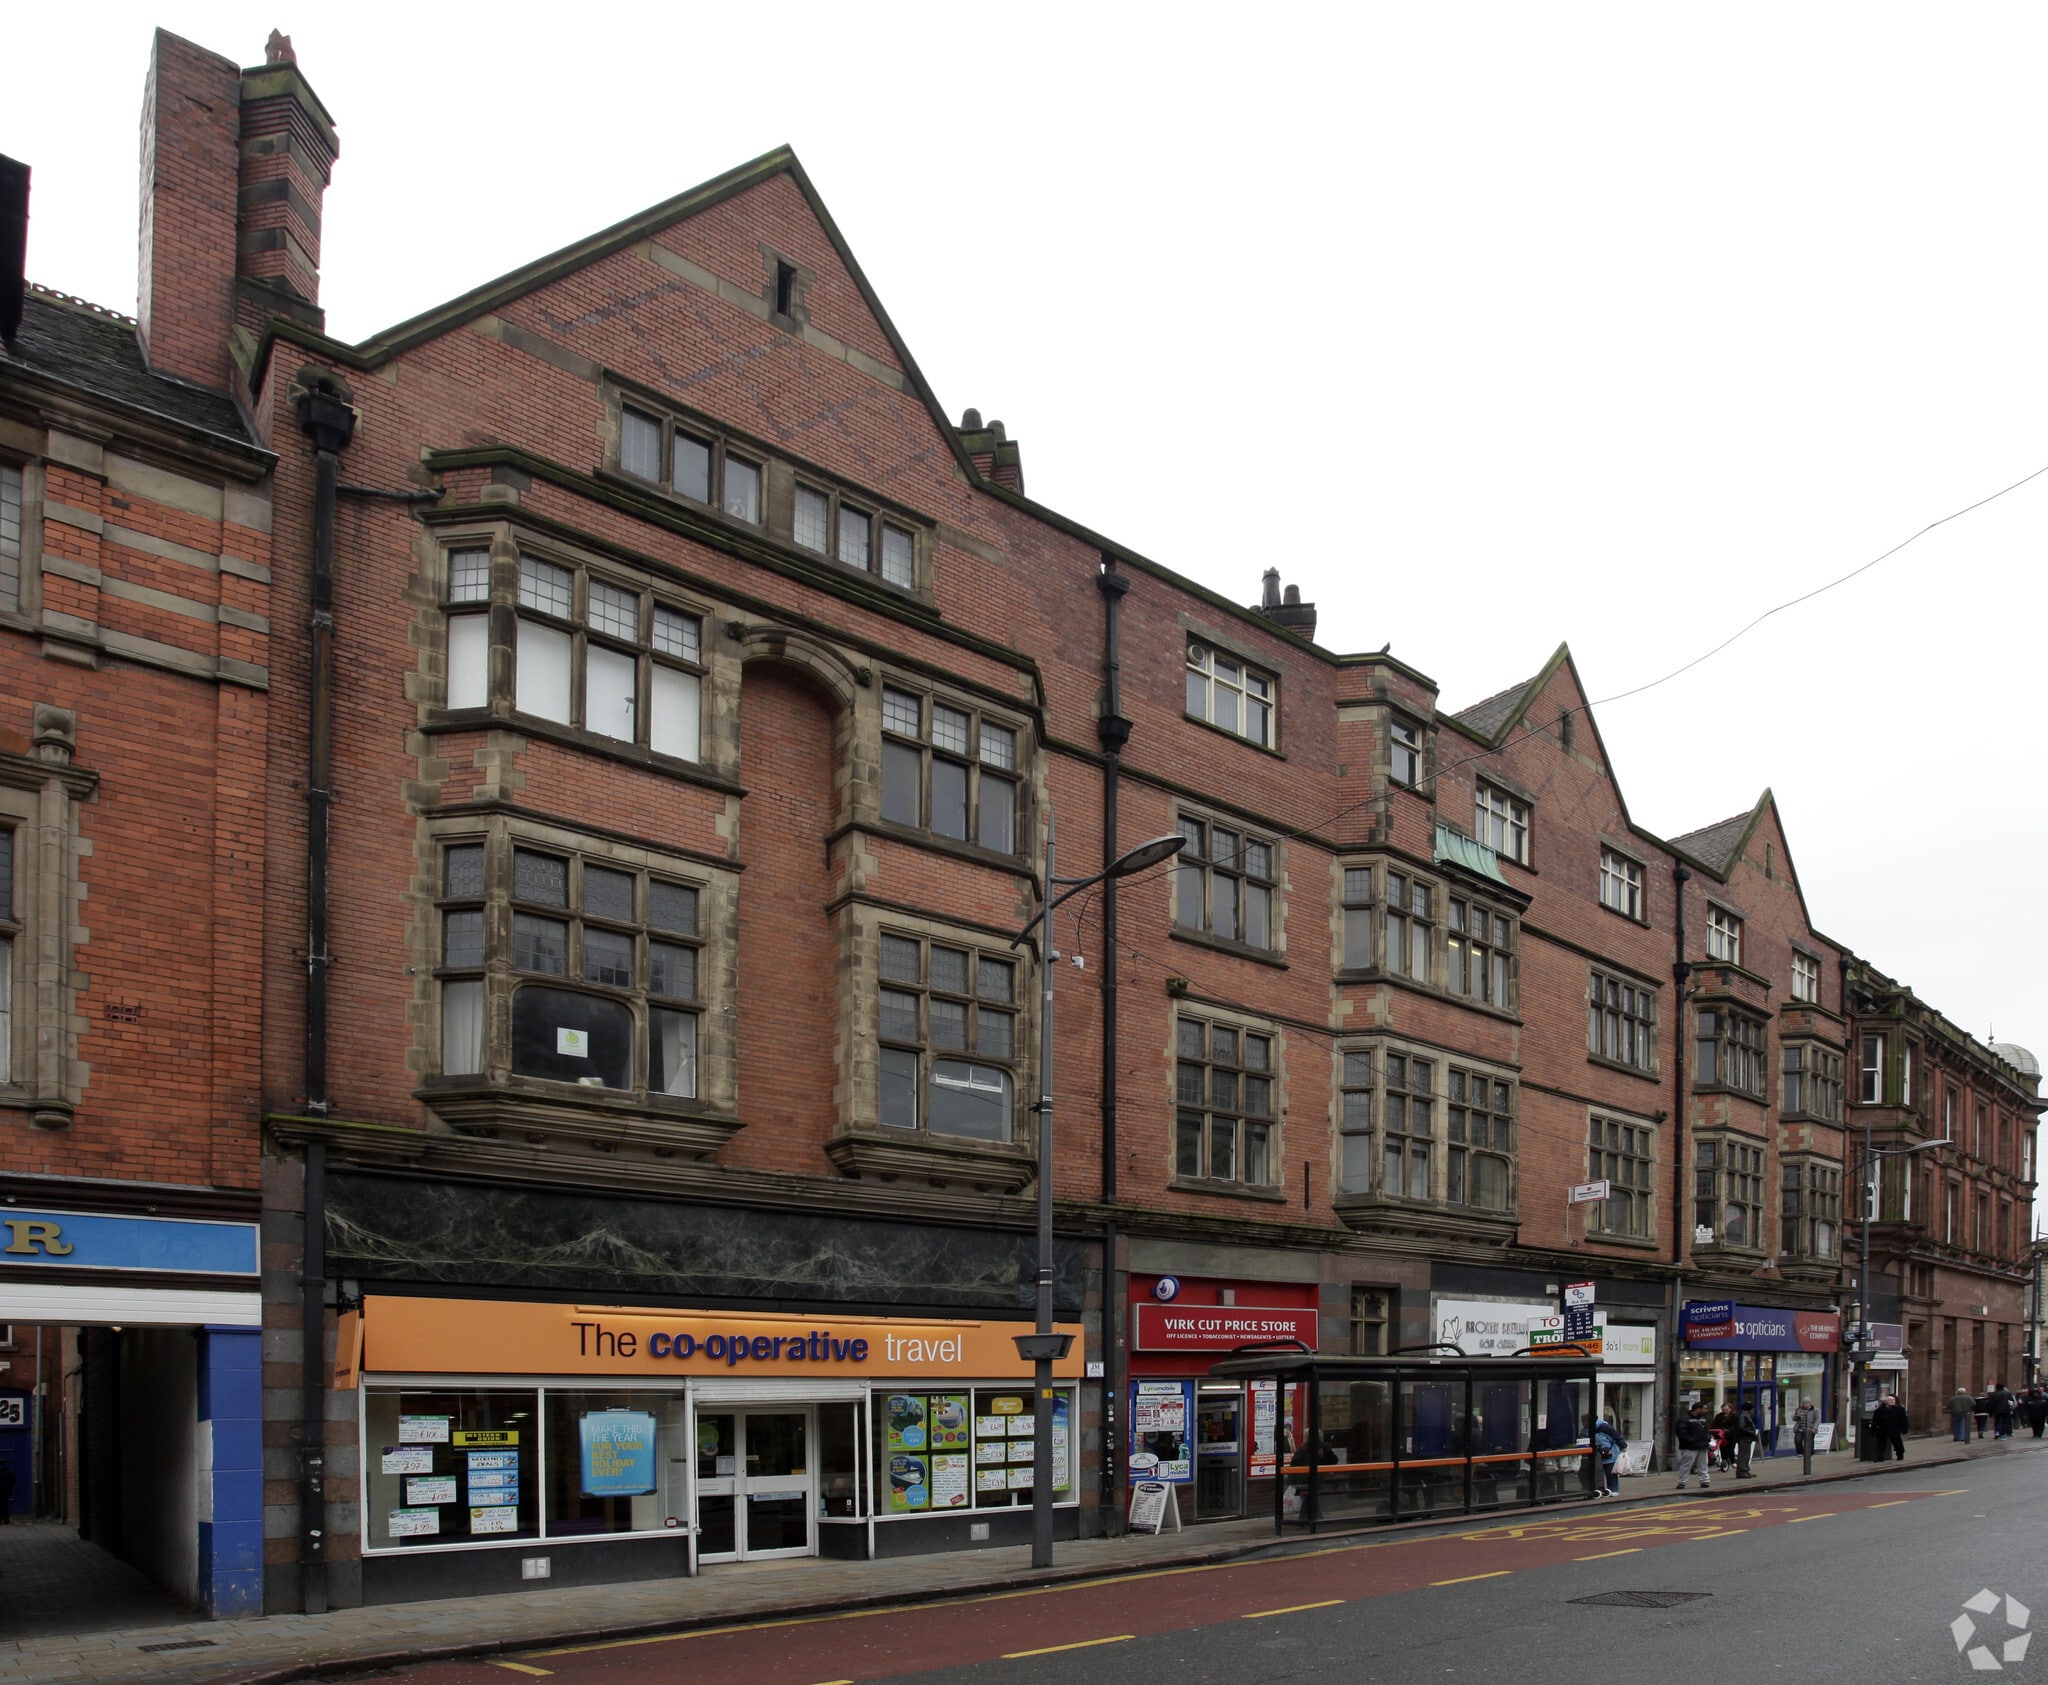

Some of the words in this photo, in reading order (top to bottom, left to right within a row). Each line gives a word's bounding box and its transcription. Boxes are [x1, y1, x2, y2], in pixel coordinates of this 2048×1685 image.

[4, 1220, 73, 1255] R
[1690, 1304, 1729, 1314] scrivens
[1690, 1311, 1729, 1322] opticians
[1164, 1319, 1195, 1330] VIRK
[1198, 1320, 1222, 1331] CUT
[1225, 1320, 1258, 1331] PRICE
[1261, 1321, 1296, 1332] STORE
[1540, 1317, 1560, 1328] TO
[1701, 1326, 1730, 1334] HEARING
[1746, 1320, 1786, 1339] opticians
[571, 1322, 636, 1357] The
[648, 1330, 869, 1367] co-operative
[884, 1333, 962, 1363] travel
[1143, 1384, 1176, 1392] Lycamobile
[0, 1399, 20, 1423] 25
[592, 1424, 619, 1434] MAKE
[622, 1424, 642, 1434] THIS
[592, 1433, 609, 1442] THE
[612, 1433, 637, 1442] YEAR
[592, 1442, 612, 1451] FOR
[616, 1442, 643, 1450] YOUR
[592, 1450, 618, 1459] BEST
[592, 1458, 636, 1468] HOLIDAY
[592, 1467, 623, 1477] EVER!
[1462, 1526, 1722, 1541] STOP
